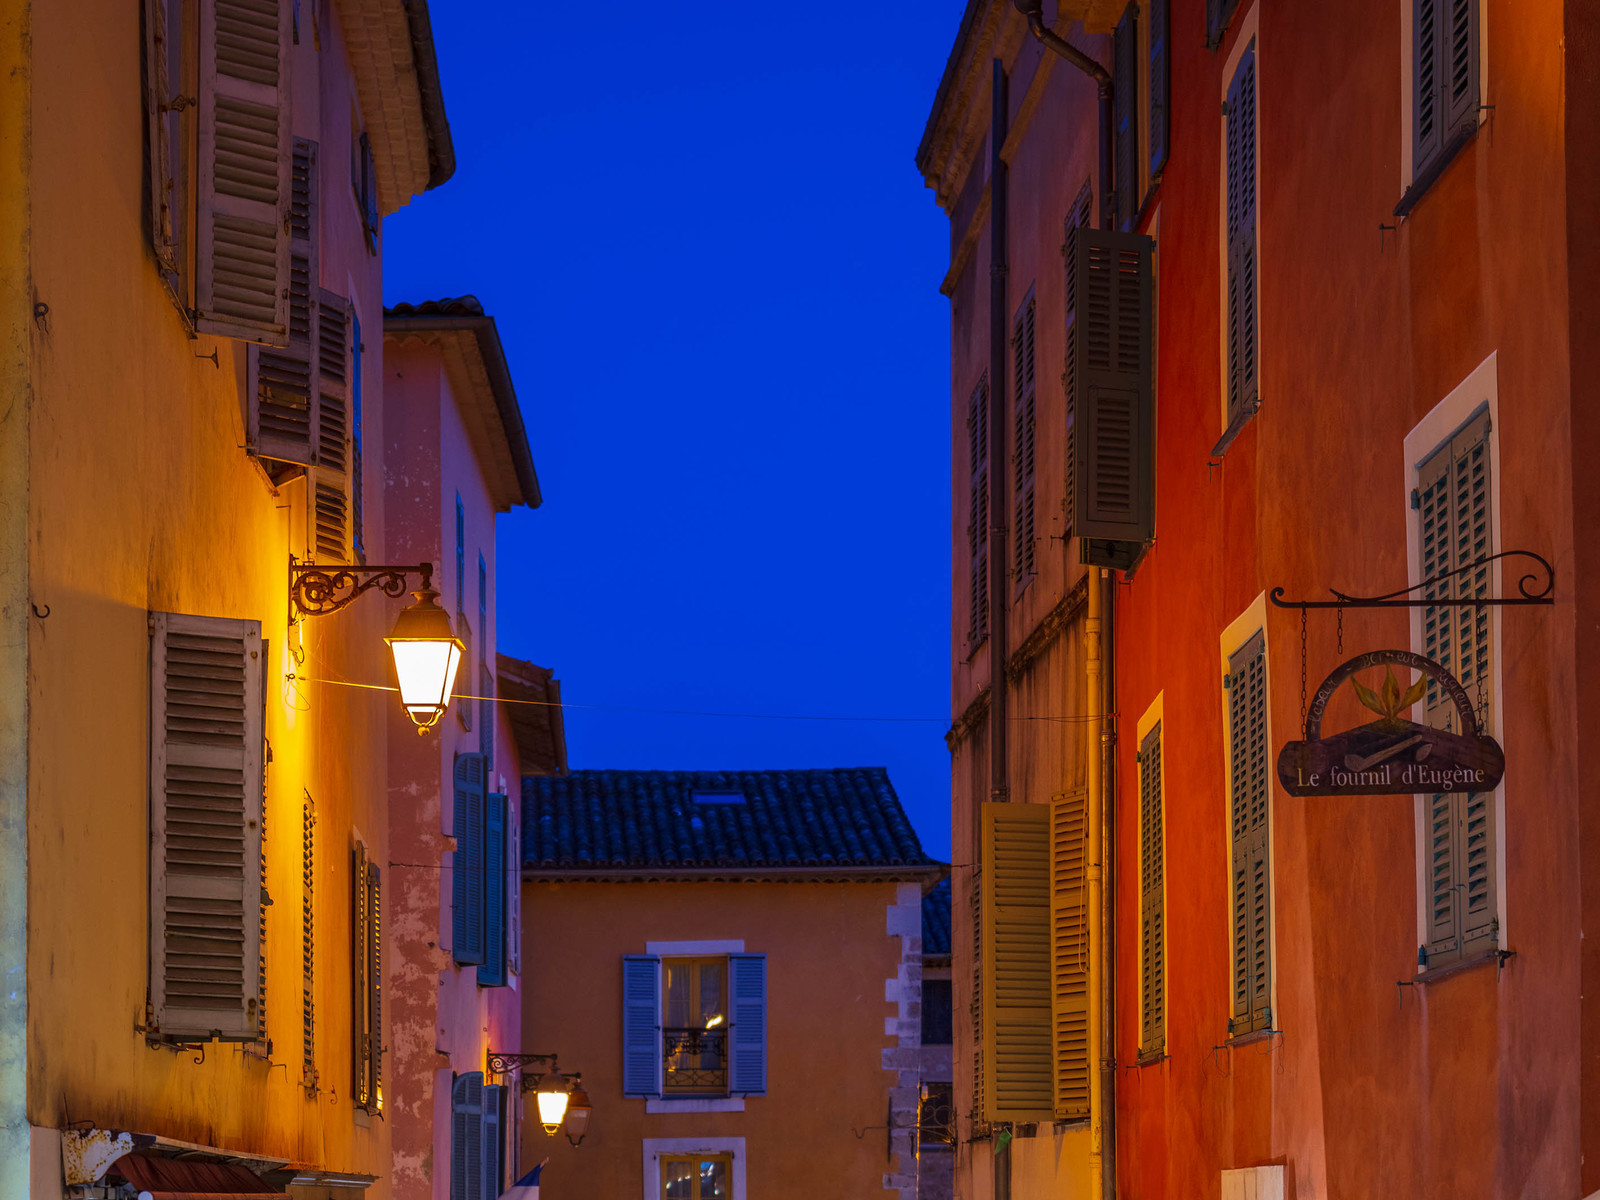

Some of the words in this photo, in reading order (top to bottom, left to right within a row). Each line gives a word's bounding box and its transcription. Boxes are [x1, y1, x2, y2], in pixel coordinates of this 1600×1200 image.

[1297, 768, 1320, 787] Le
[1330, 765, 1391, 786] fournil
[1402, 764, 1486, 791] d'Eugène
